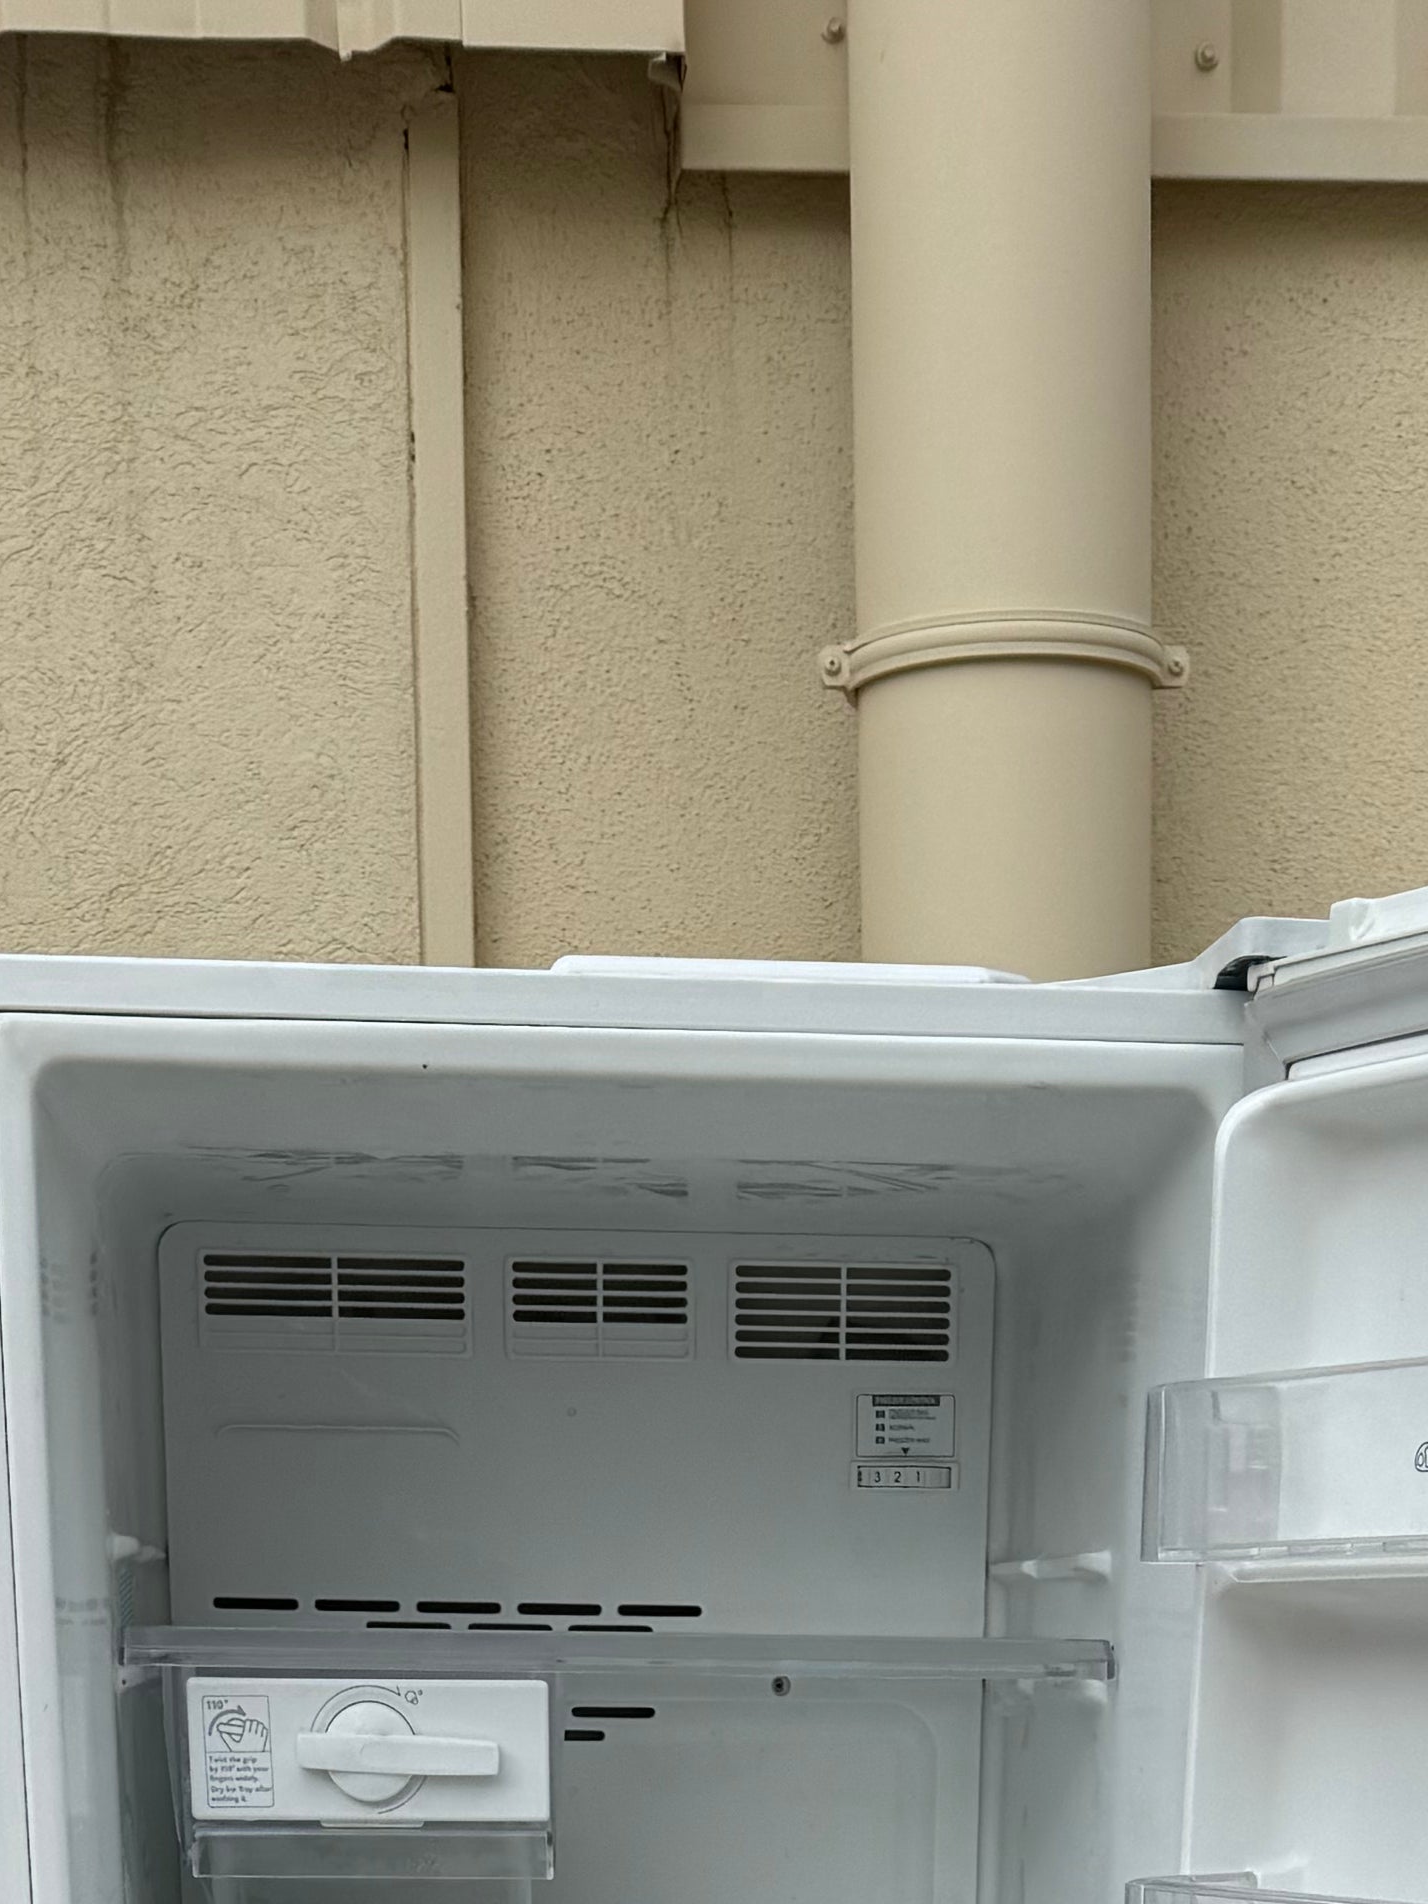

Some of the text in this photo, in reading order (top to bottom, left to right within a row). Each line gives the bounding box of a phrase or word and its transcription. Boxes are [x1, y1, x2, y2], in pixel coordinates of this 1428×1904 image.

[874, 1471, 881, 1483] 3
[894, 1471, 901, 1483] 2
[916, 1471, 920, 1483] 1
